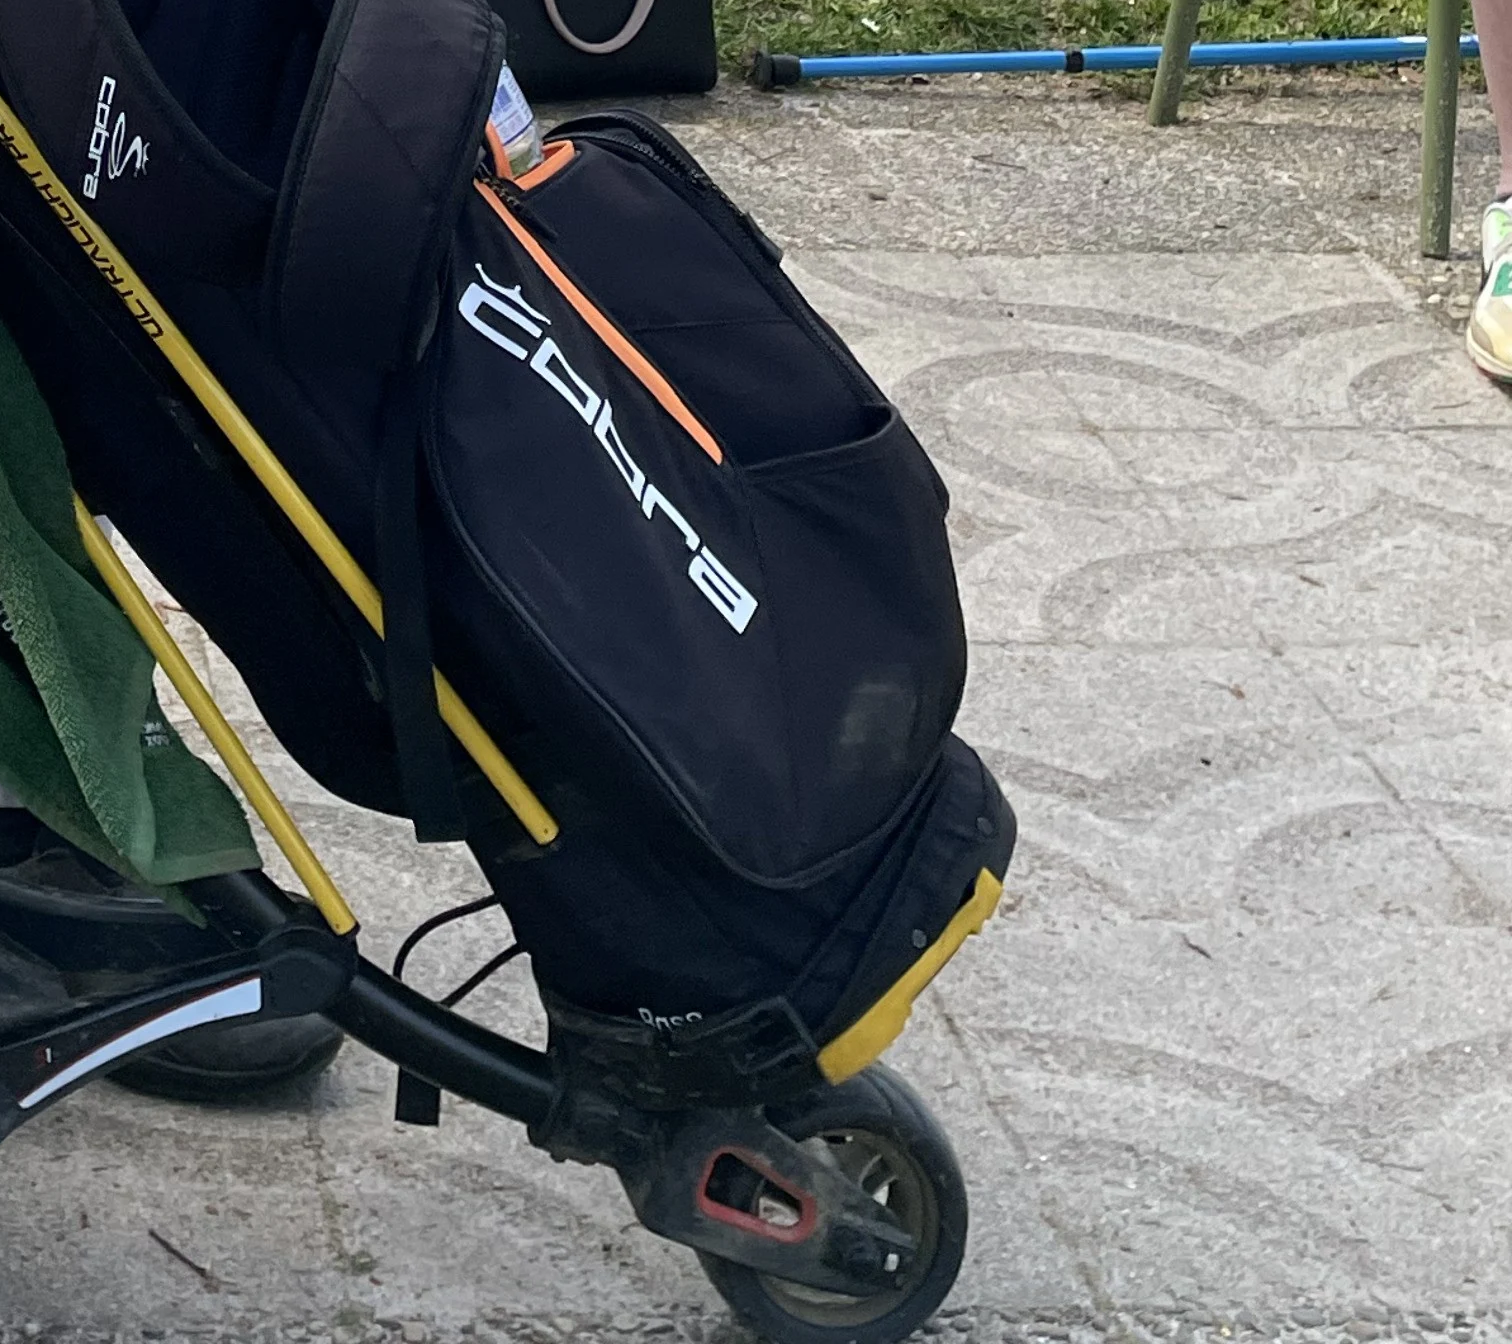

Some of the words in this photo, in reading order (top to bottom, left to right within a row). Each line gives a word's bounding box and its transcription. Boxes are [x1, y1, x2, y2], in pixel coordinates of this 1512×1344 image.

[82, 75, 116, 200] cobra
[30, 170, 164, 339] ULTRALIGHT
[458, 280, 759, 635] cobra
